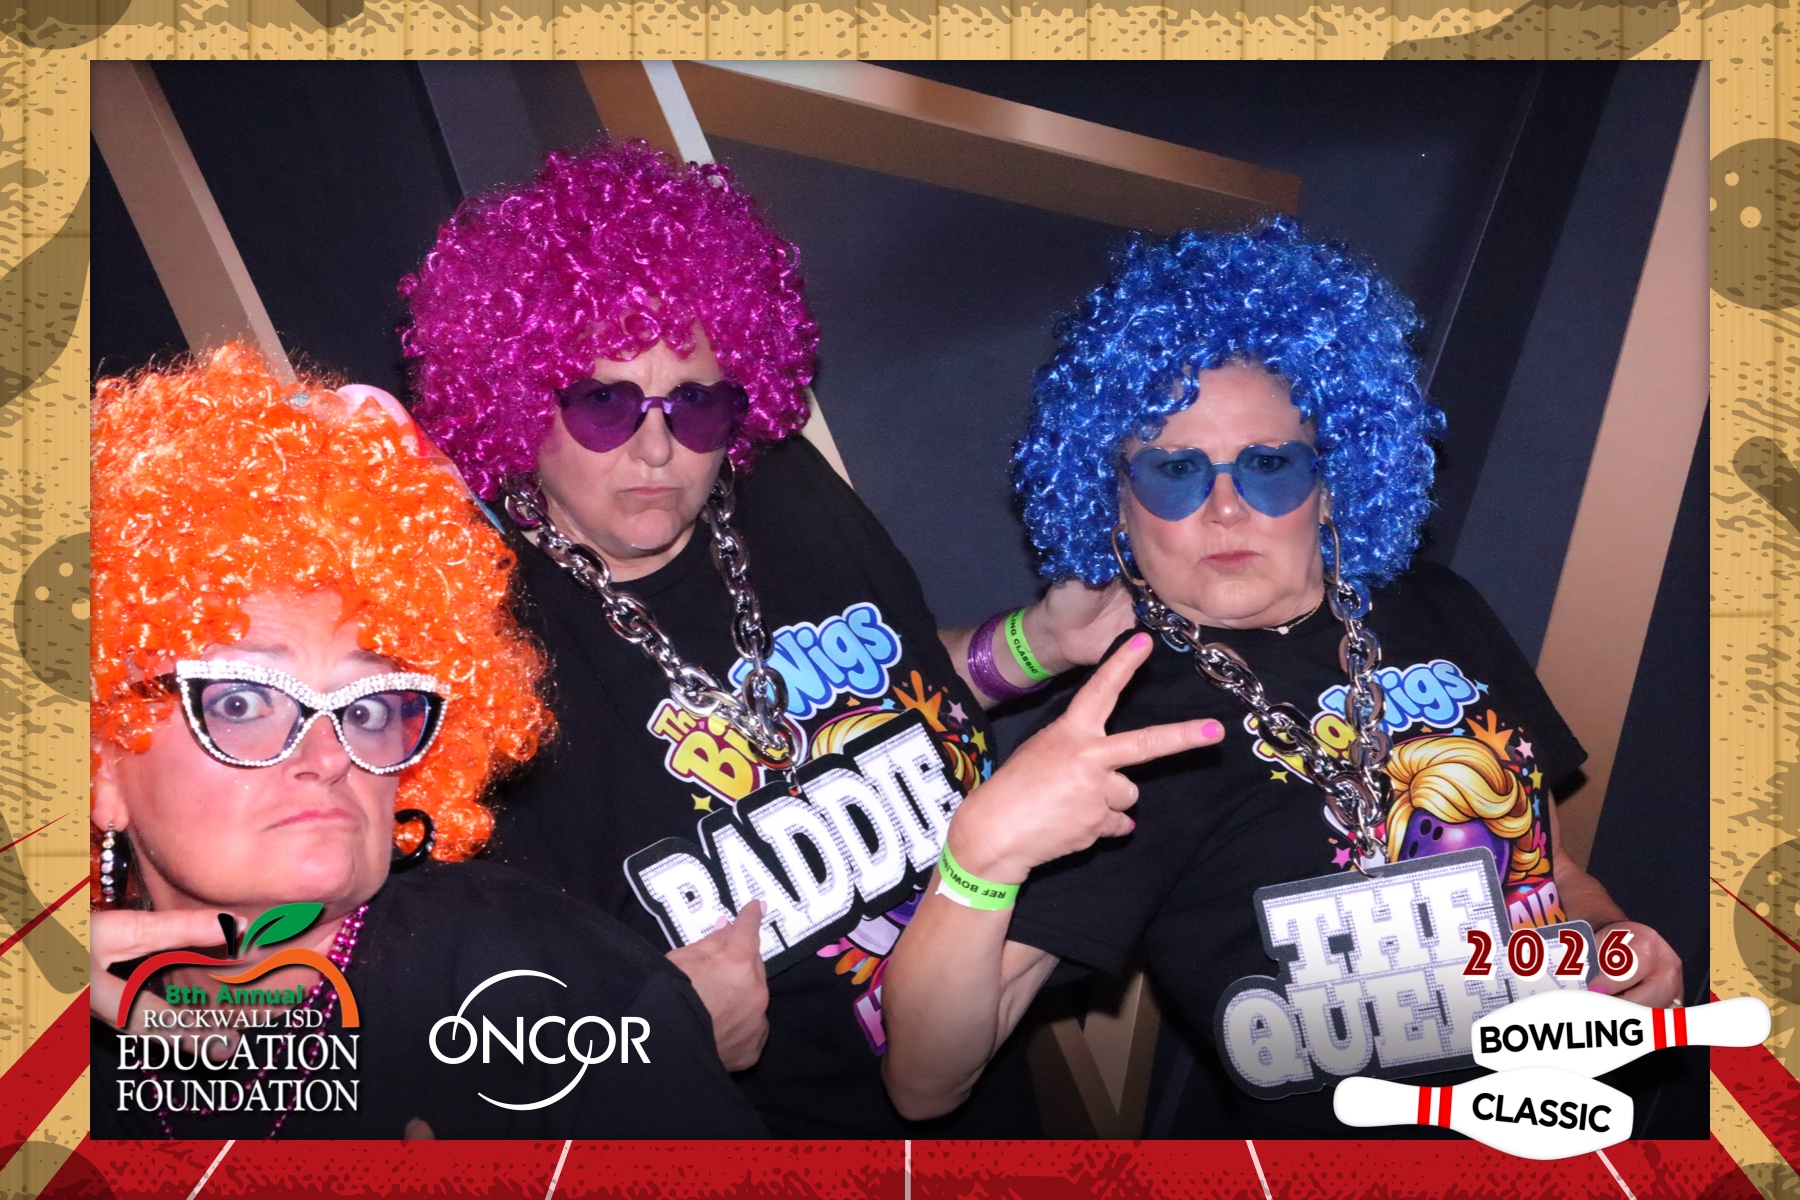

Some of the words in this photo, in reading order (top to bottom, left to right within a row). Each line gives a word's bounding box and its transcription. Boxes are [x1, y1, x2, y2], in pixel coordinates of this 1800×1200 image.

[1013, 638, 1039, 674] CLASSIC
[638, 722, 964, 962] BADDIE
[981, 889, 1007, 899] REF
[1262, 859, 1498, 984] THE
